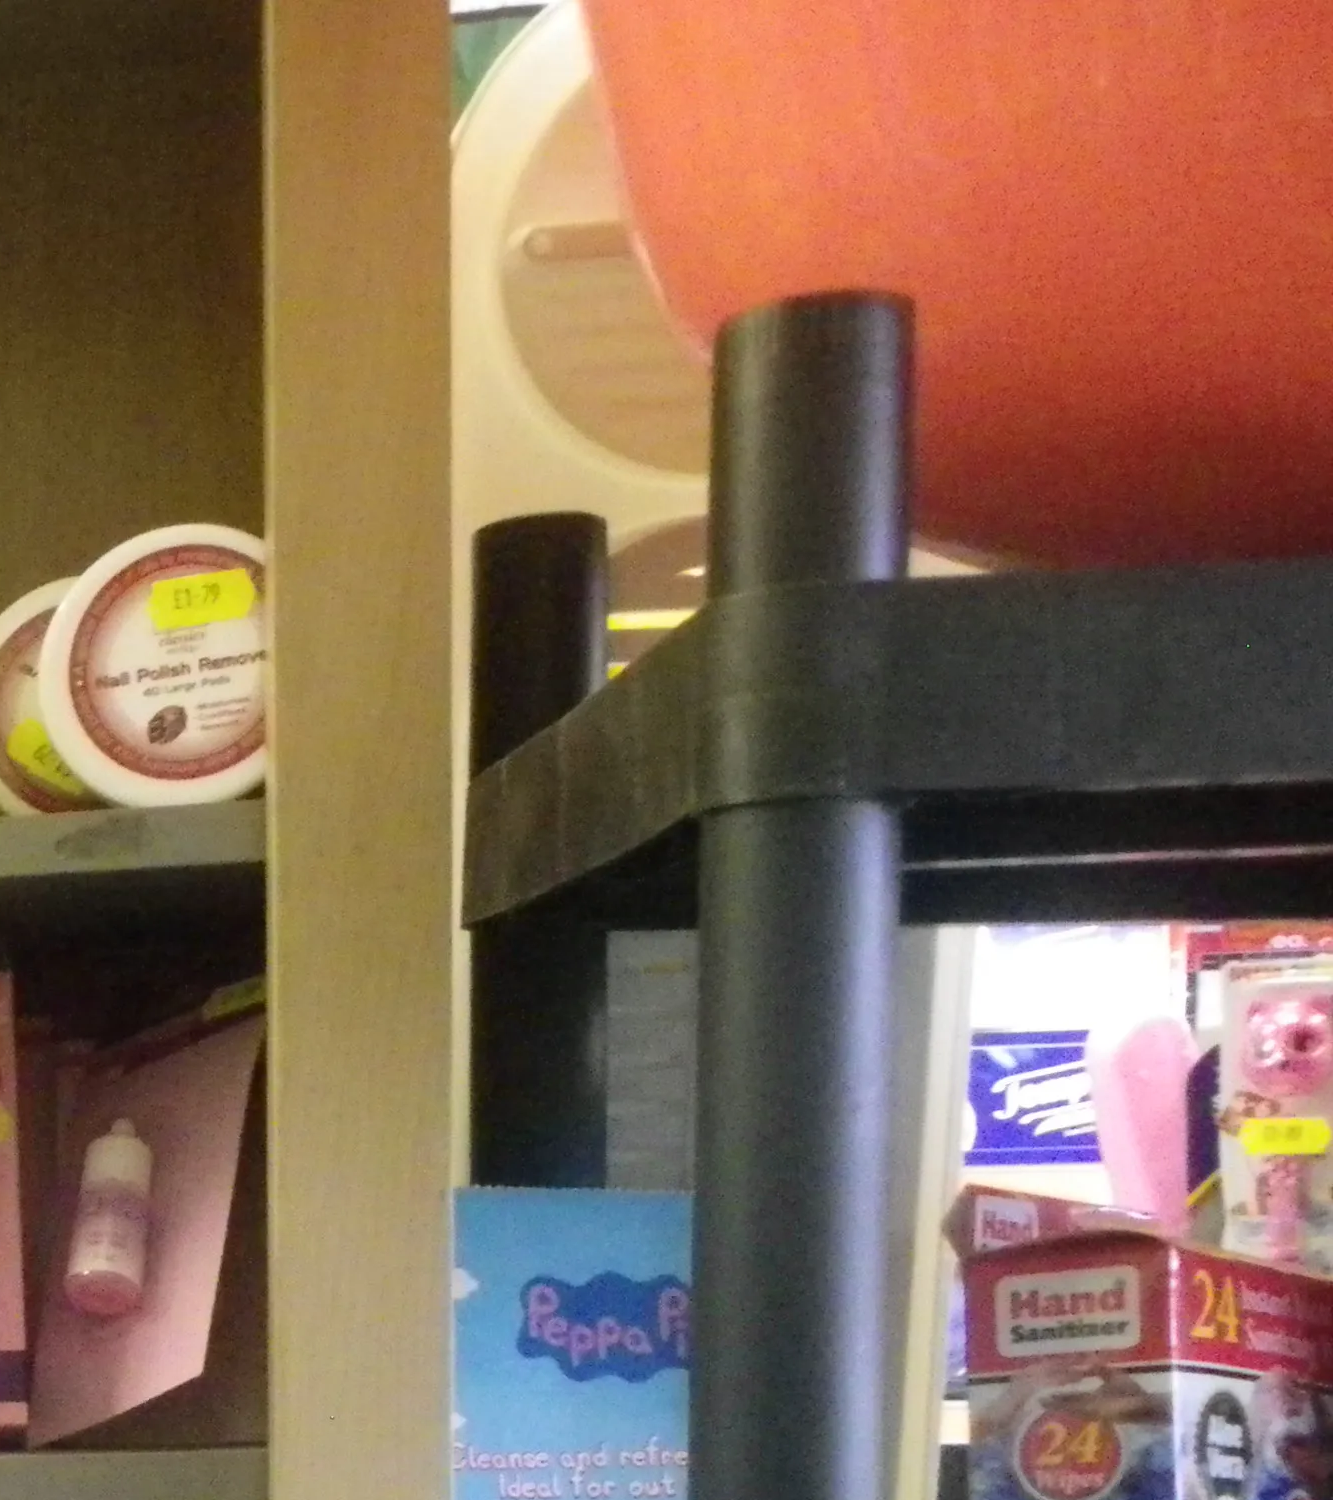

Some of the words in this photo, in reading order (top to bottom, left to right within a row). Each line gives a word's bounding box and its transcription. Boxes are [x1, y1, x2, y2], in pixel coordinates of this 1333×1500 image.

[136, 662, 192, 683] Polish
[198, 649, 268, 672] Remove
[1010, 1277, 1127, 1320] Hand
[1190, 1268, 1239, 1344] 24
[528, 1283, 653, 1368] Peppa
[658, 1287, 689, 1358] Pi
[452, 1440, 551, 1470] Cleanse
[560, 1440, 608, 1469] and
[620, 1435, 690, 1468] refre
[1036, 1420, 1103, 1465] 24
[499, 1473, 563, 1499] Ideal
[570, 1467, 617, 1498] for
